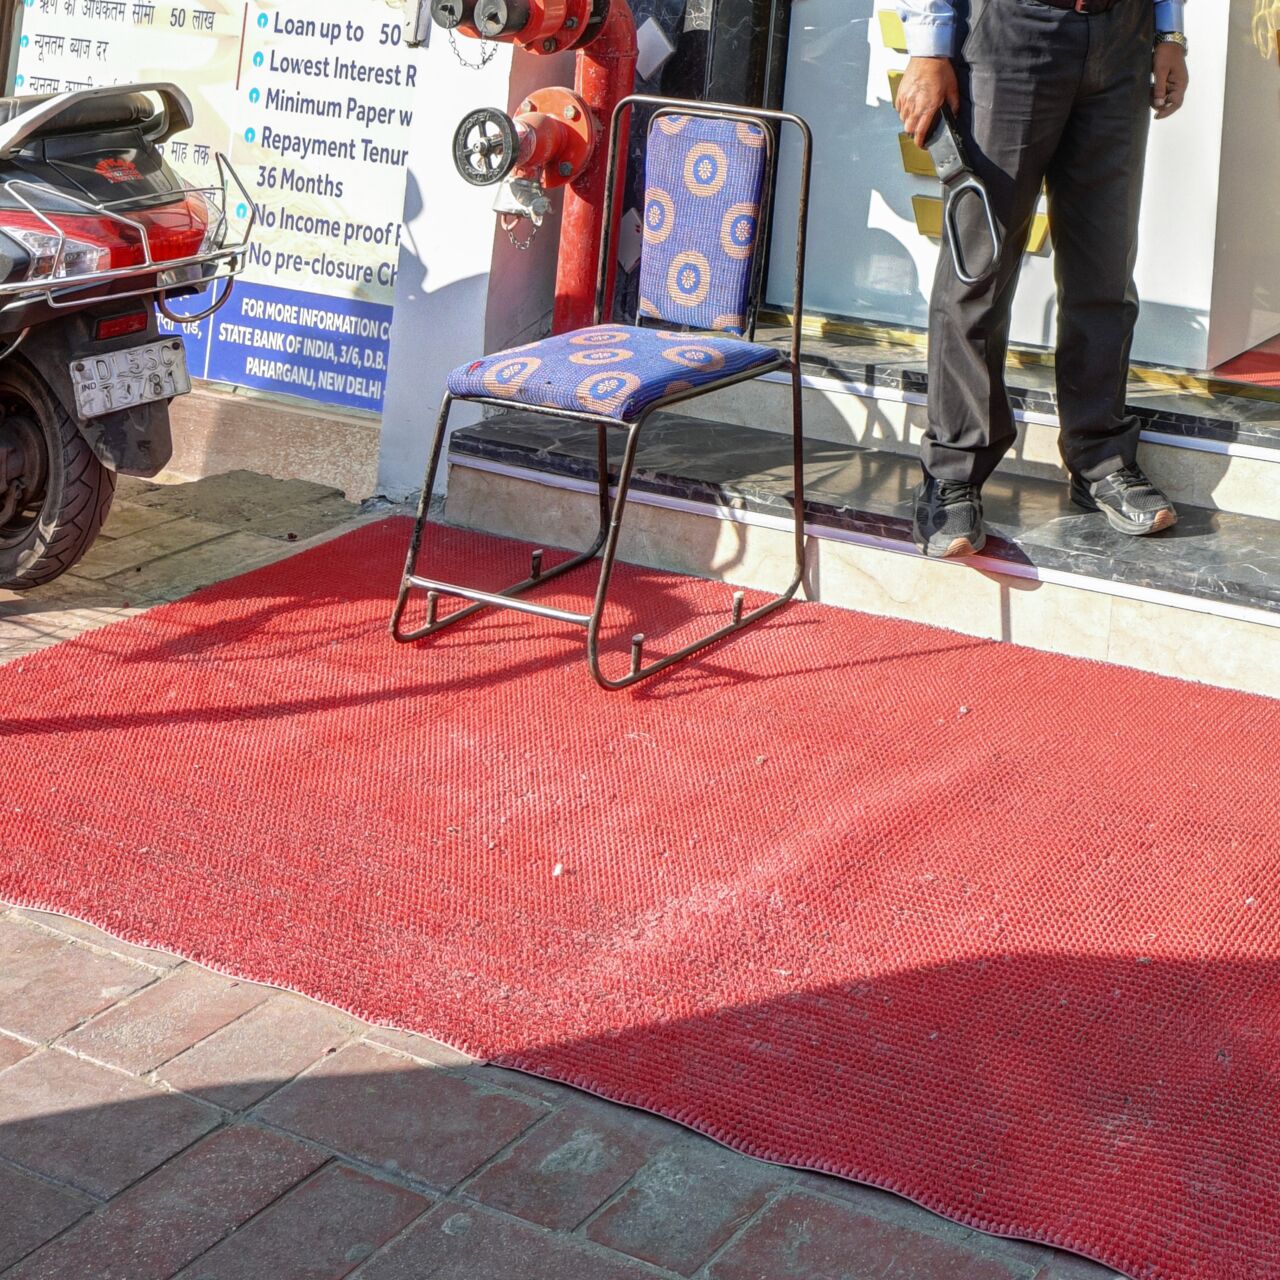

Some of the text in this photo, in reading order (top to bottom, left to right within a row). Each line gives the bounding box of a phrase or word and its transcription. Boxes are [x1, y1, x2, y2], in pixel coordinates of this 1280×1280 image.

[169, 7, 187, 28] 50
[193, 9, 216, 32] लाख
[274, 11, 402, 46] Loan up to 50
[34, 33, 110, 63] न्यूनतम ब्याज दर
[269, 49, 418, 88] Lowest Interest R
[265, 87, 414, 129] Minimum Paper w
[171, 141, 189, 164] माह
[193, 144, 210, 166] तक
[261, 125, 409, 167] Repayment Tenur
[256, 165, 344, 199] 36 Months
[253, 202, 276, 228] No
[279, 207, 342, 238] Income
[343, 222, 394, 246] proof
[249, 241, 272, 267] No
[274, 253, 374, 284] pre-closure
[241, 297, 264, 318] FOR
[265, 302, 298, 324] MORE
[299, 307, 380, 340] INFORMATION
[218, 322, 387, 371] STATE BANK OF INDIA, 3/6, D.B.
[81, 381, 98, 394] IND
[245, 356, 383, 400] PAHARGANJ, NEW DELHI
